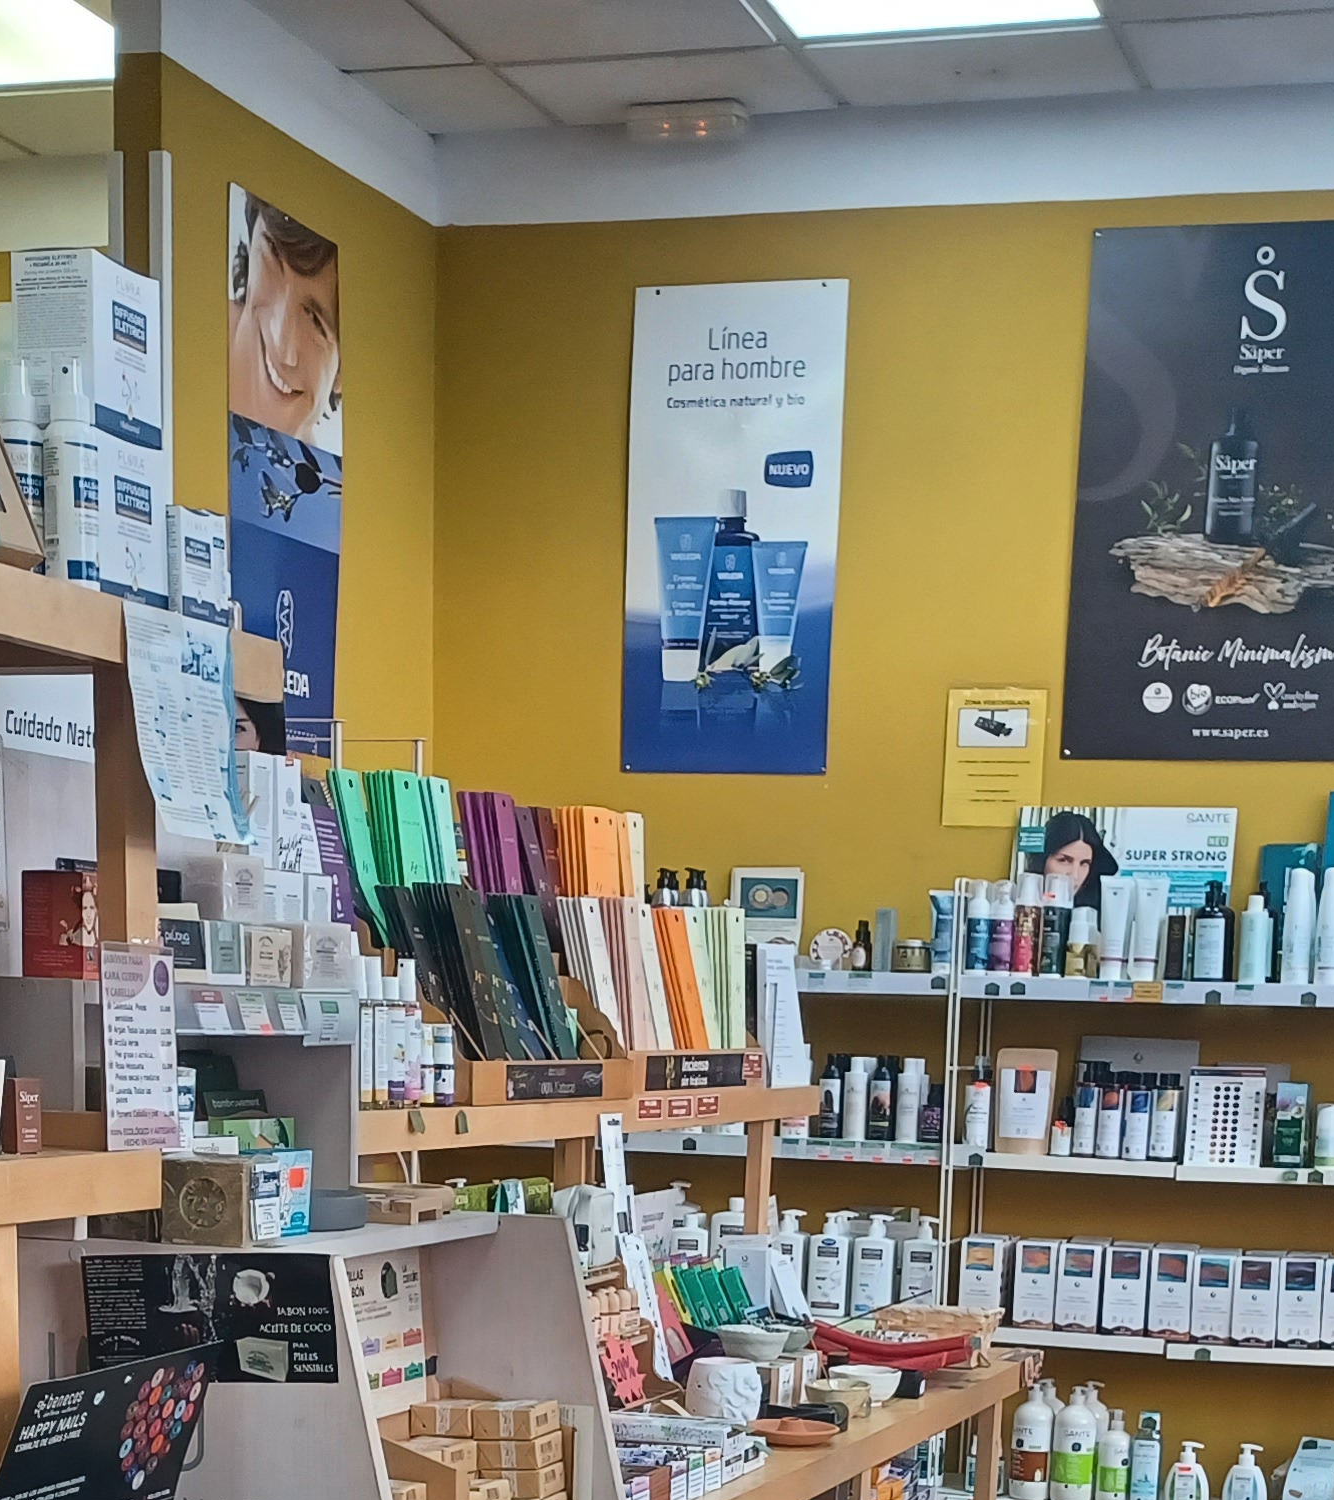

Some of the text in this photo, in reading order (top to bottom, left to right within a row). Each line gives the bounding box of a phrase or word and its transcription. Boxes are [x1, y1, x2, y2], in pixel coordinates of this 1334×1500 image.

[708, 326, 768, 352] Línea
[668, 356, 806, 387] para hombre
[667, 393, 806, 411] Cosmética natural y bio
[769, 463, 810, 476] NUEVO
[1137, 633, 1215, 671] Botanic
[5, 709, 62, 744] Cuidado
[1186, 812, 1230, 825] SANTE
[1125, 849, 1228, 862] SUPER STRONG
[277, 1306, 329, 1316] JABON 100%
[259, 1323, 332, 1334] ACEITE DE COCO
[293, 1352, 319, 1361] PIELES
[293, 1363, 334, 1374] SENSIBLES
[19, 1411, 88, 1442] HAPPY NAILS
